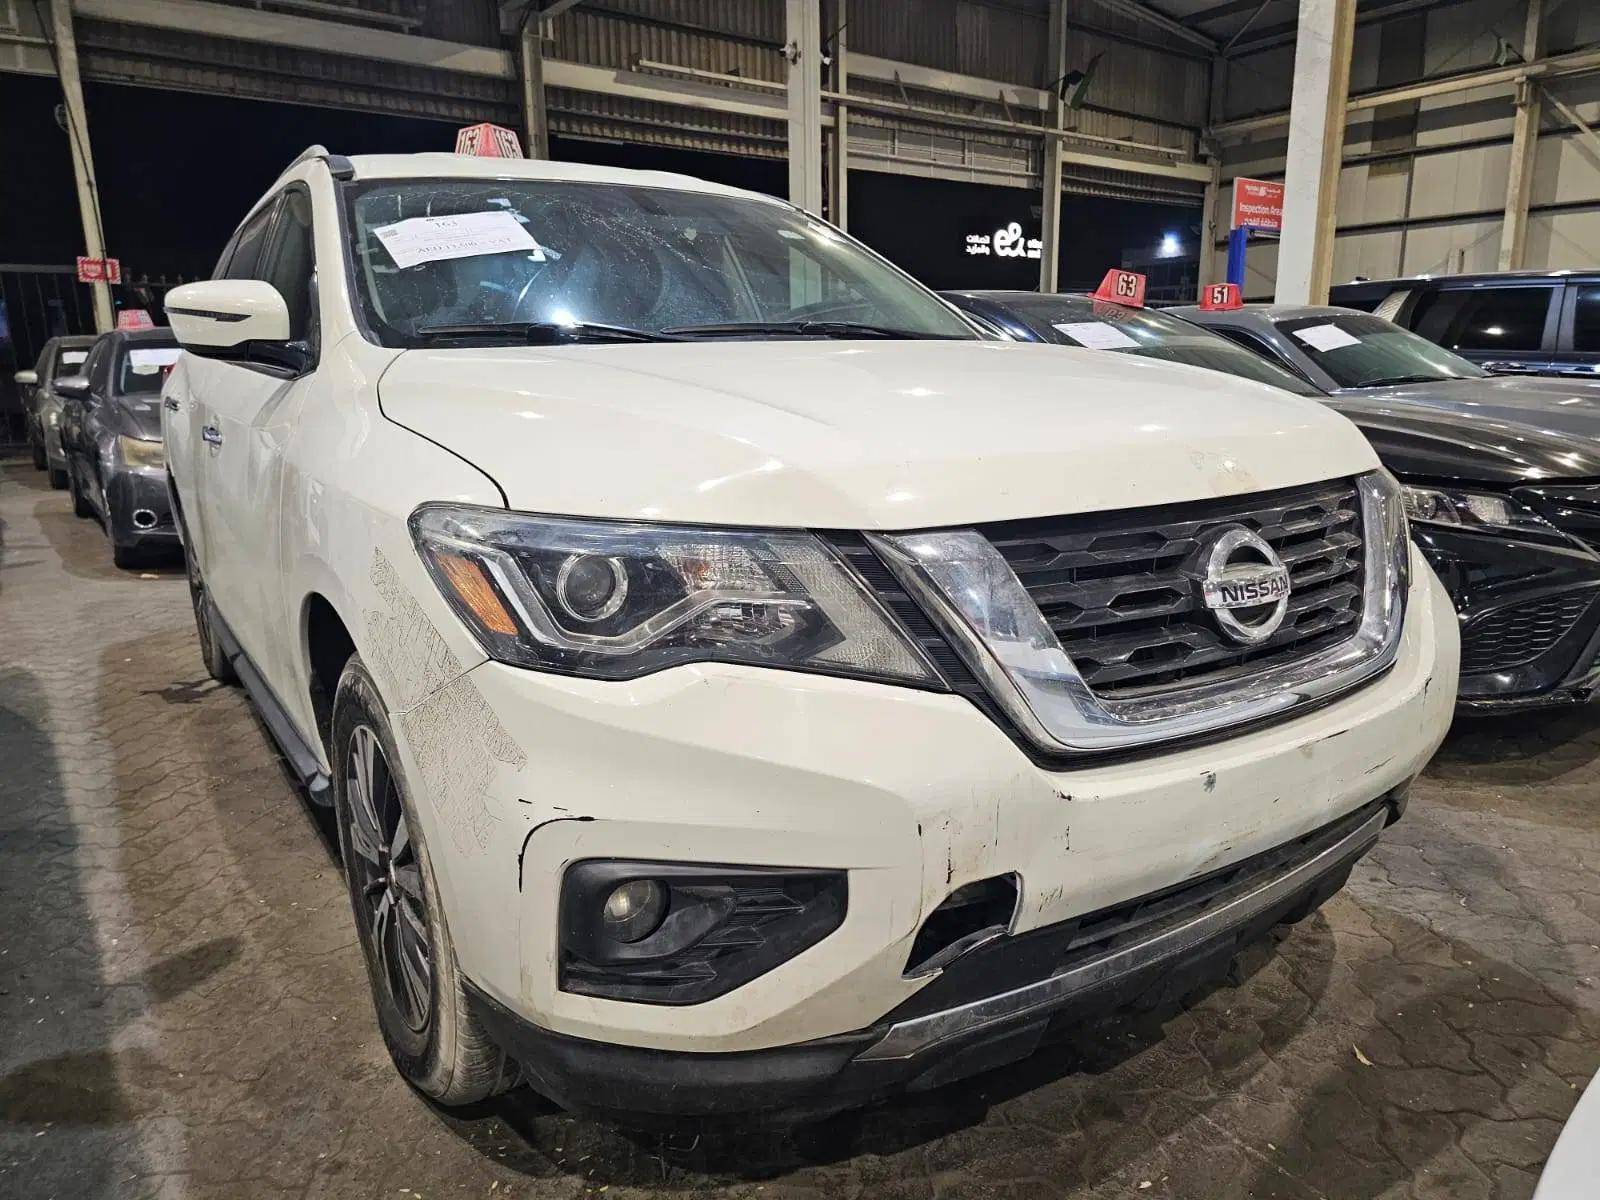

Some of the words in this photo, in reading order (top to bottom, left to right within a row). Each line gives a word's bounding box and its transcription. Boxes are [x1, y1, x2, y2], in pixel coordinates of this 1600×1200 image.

[460, 129, 480, 158] 163
[494, 128, 523, 159] 163
[1240, 202, 1270, 215] Inspection
[1117, 272, 1137, 297] 63
[1212, 285, 1229, 304] 51
[1220, 575, 1289, 603] NISSAN
